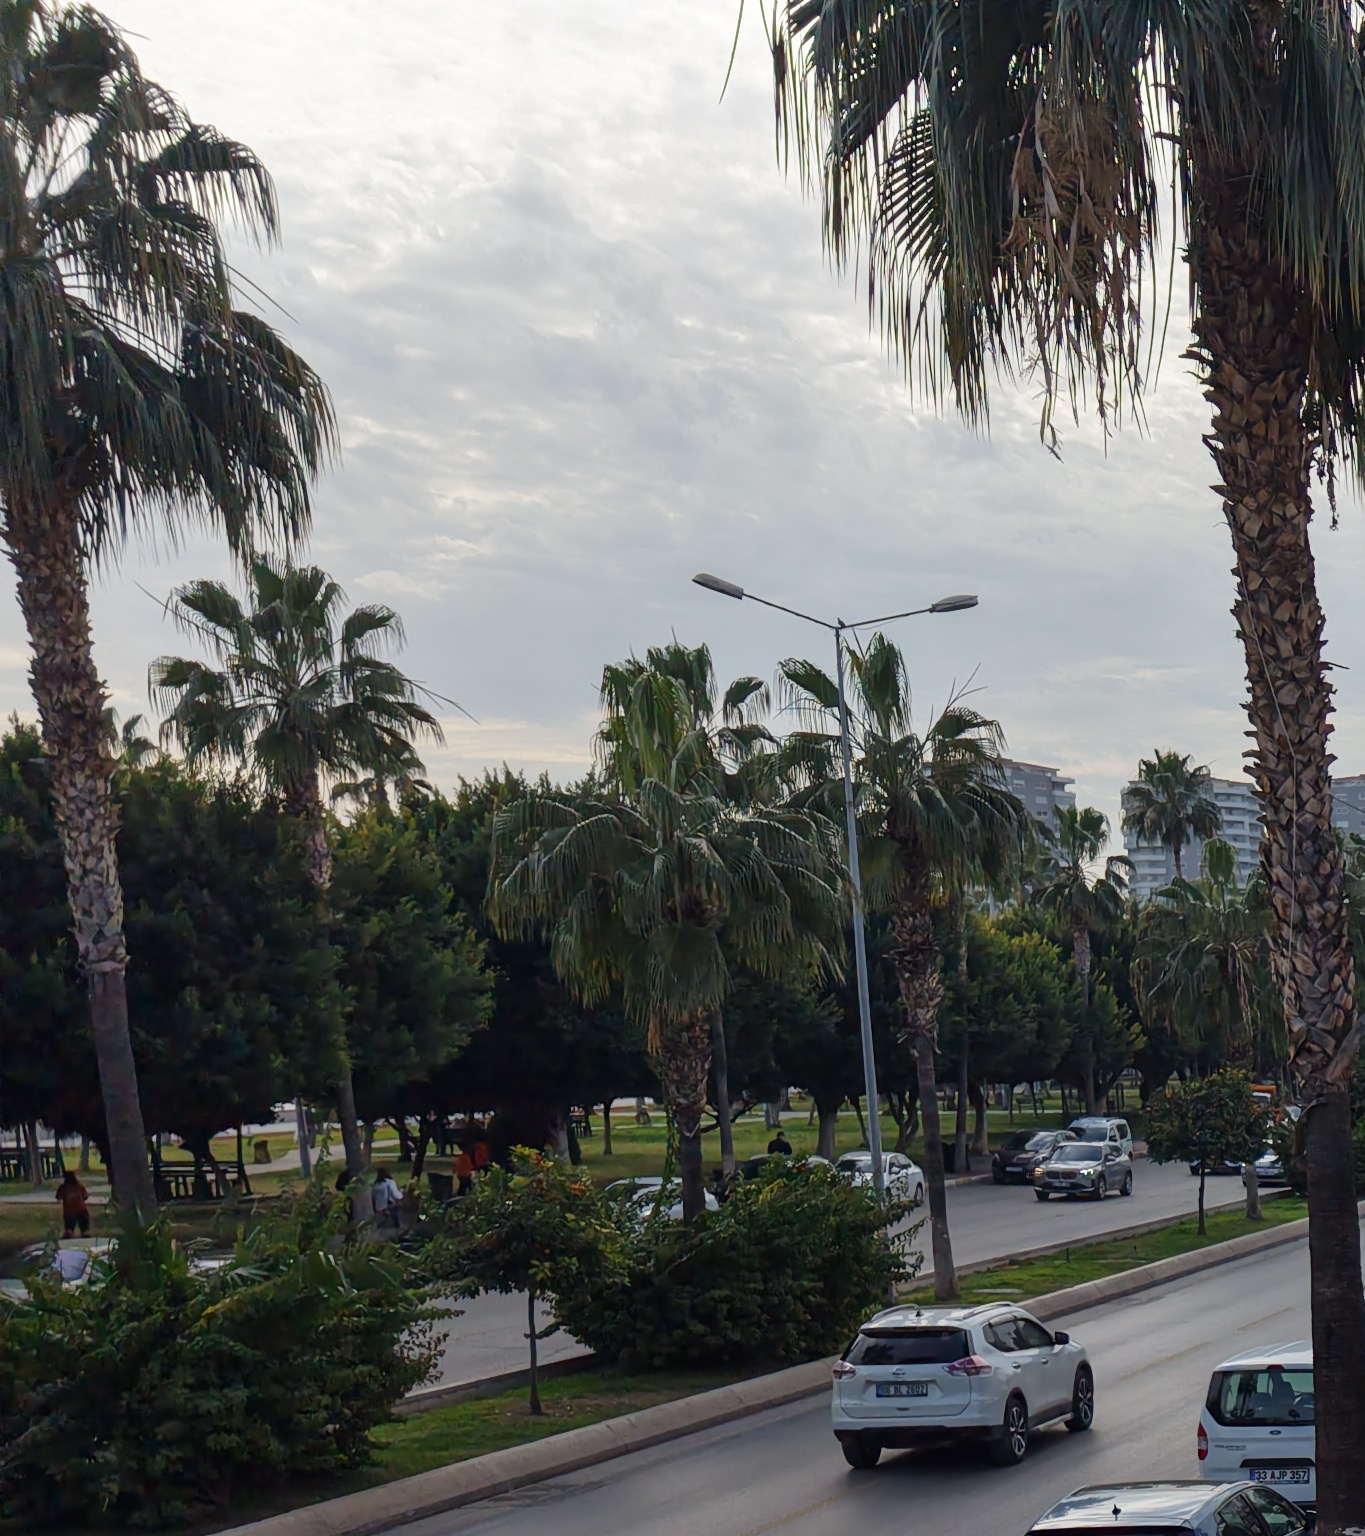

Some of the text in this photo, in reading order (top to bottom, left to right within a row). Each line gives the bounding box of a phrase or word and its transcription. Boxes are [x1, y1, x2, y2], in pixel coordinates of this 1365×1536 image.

[1255, 1470, 1307, 1480] 33 AJP 357
